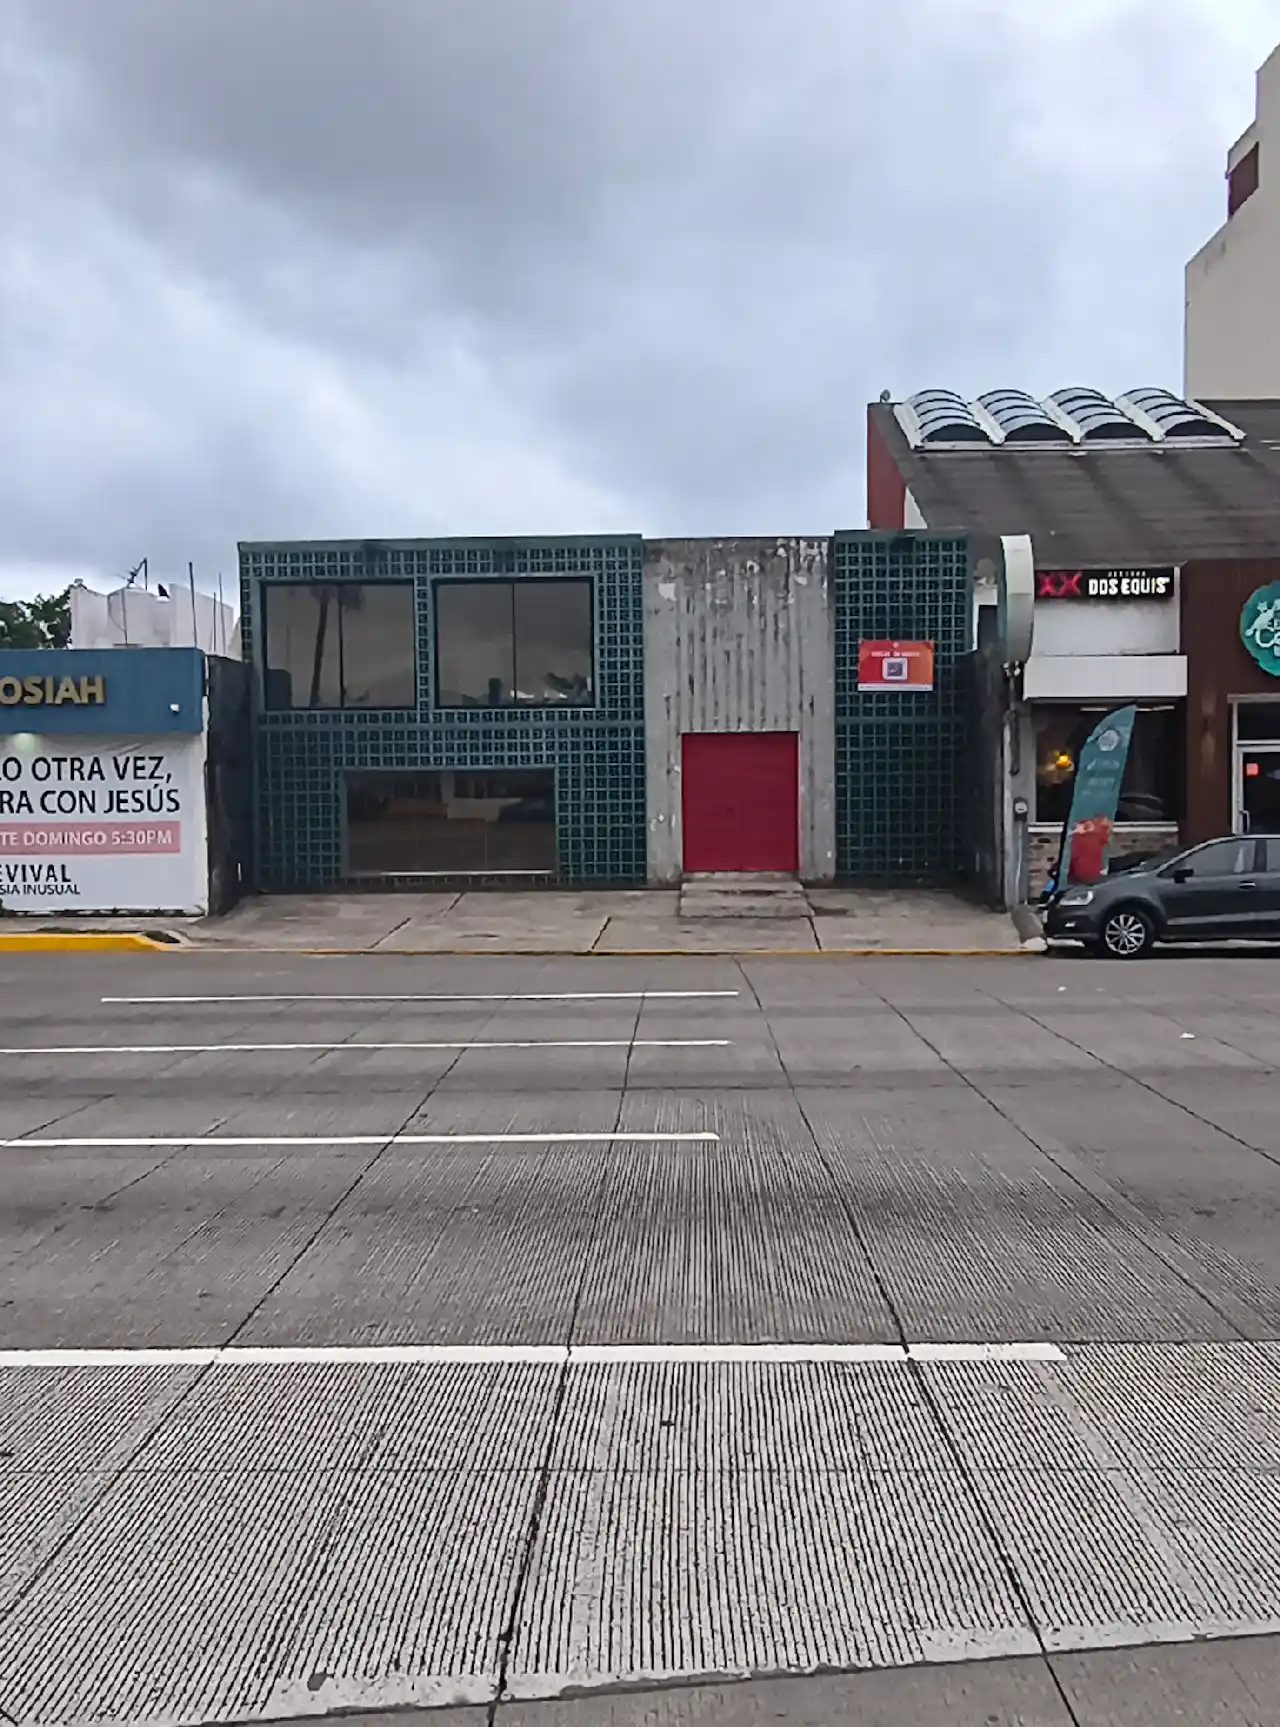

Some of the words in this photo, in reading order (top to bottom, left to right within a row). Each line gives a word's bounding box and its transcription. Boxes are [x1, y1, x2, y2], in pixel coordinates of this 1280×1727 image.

[1038, 570, 1082, 597] XX
[1088, 578, 1119, 595] DOS
[1120, 577, 1169, 595] EQUIS
[31, 756, 105, 782] OTRA
[113, 755, 172, 784] VEZ,
[40, 790, 96, 814] CON
[103, 784, 180, 814] JESÚS
[24, 830, 107, 846] DOMINGO
[111, 829, 172, 845] 5:30PM
[23, 883, 81, 896] INUSUAL
